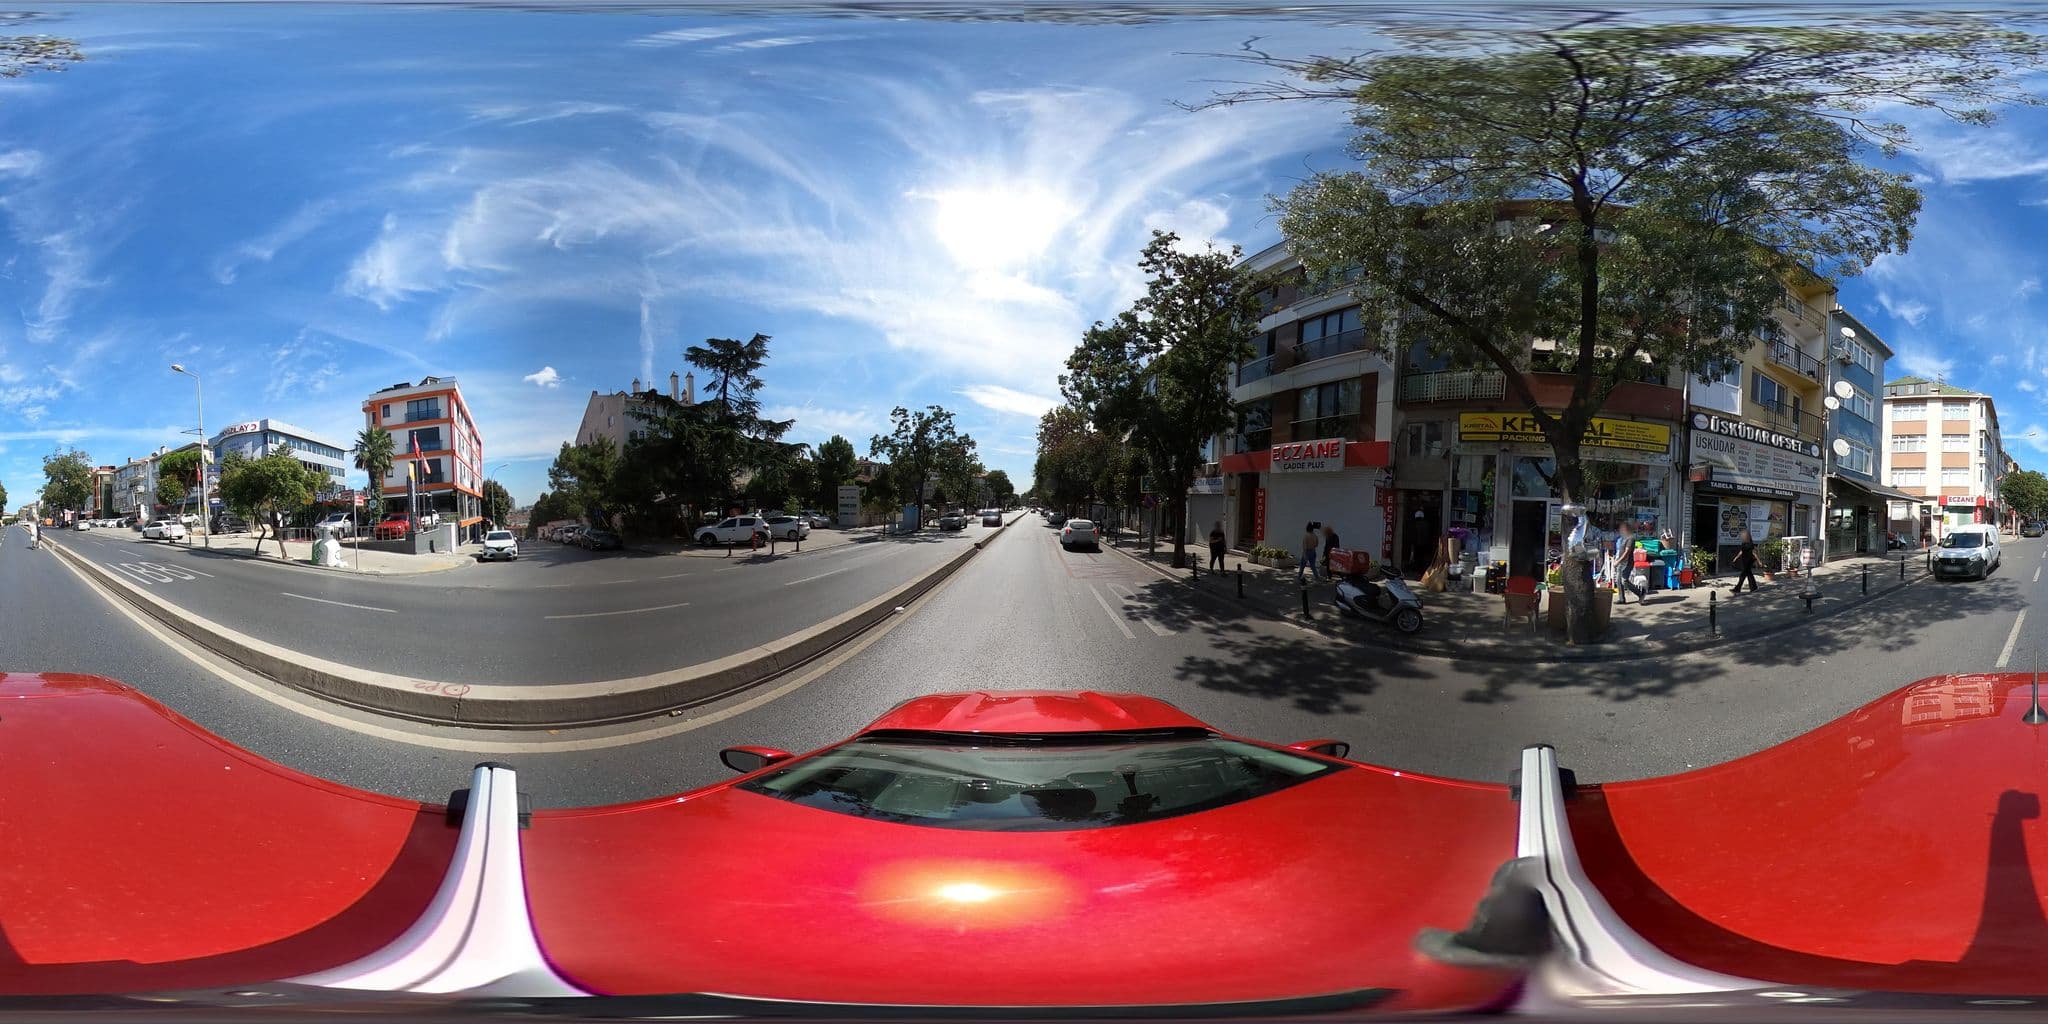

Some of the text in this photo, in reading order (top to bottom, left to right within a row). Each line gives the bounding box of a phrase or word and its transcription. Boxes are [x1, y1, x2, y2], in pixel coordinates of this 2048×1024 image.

[1502, 434, 1546, 443] PACKING
[1696, 433, 1735, 454] ÜSKÜDAR
[1710, 415, 1803, 453] ÜSKÜDAR OFSET
[1272, 440, 1341, 461] ECZANE
[1307, 461, 1325, 469] PLUS
[1385, 495, 1394, 552] ECZANE
